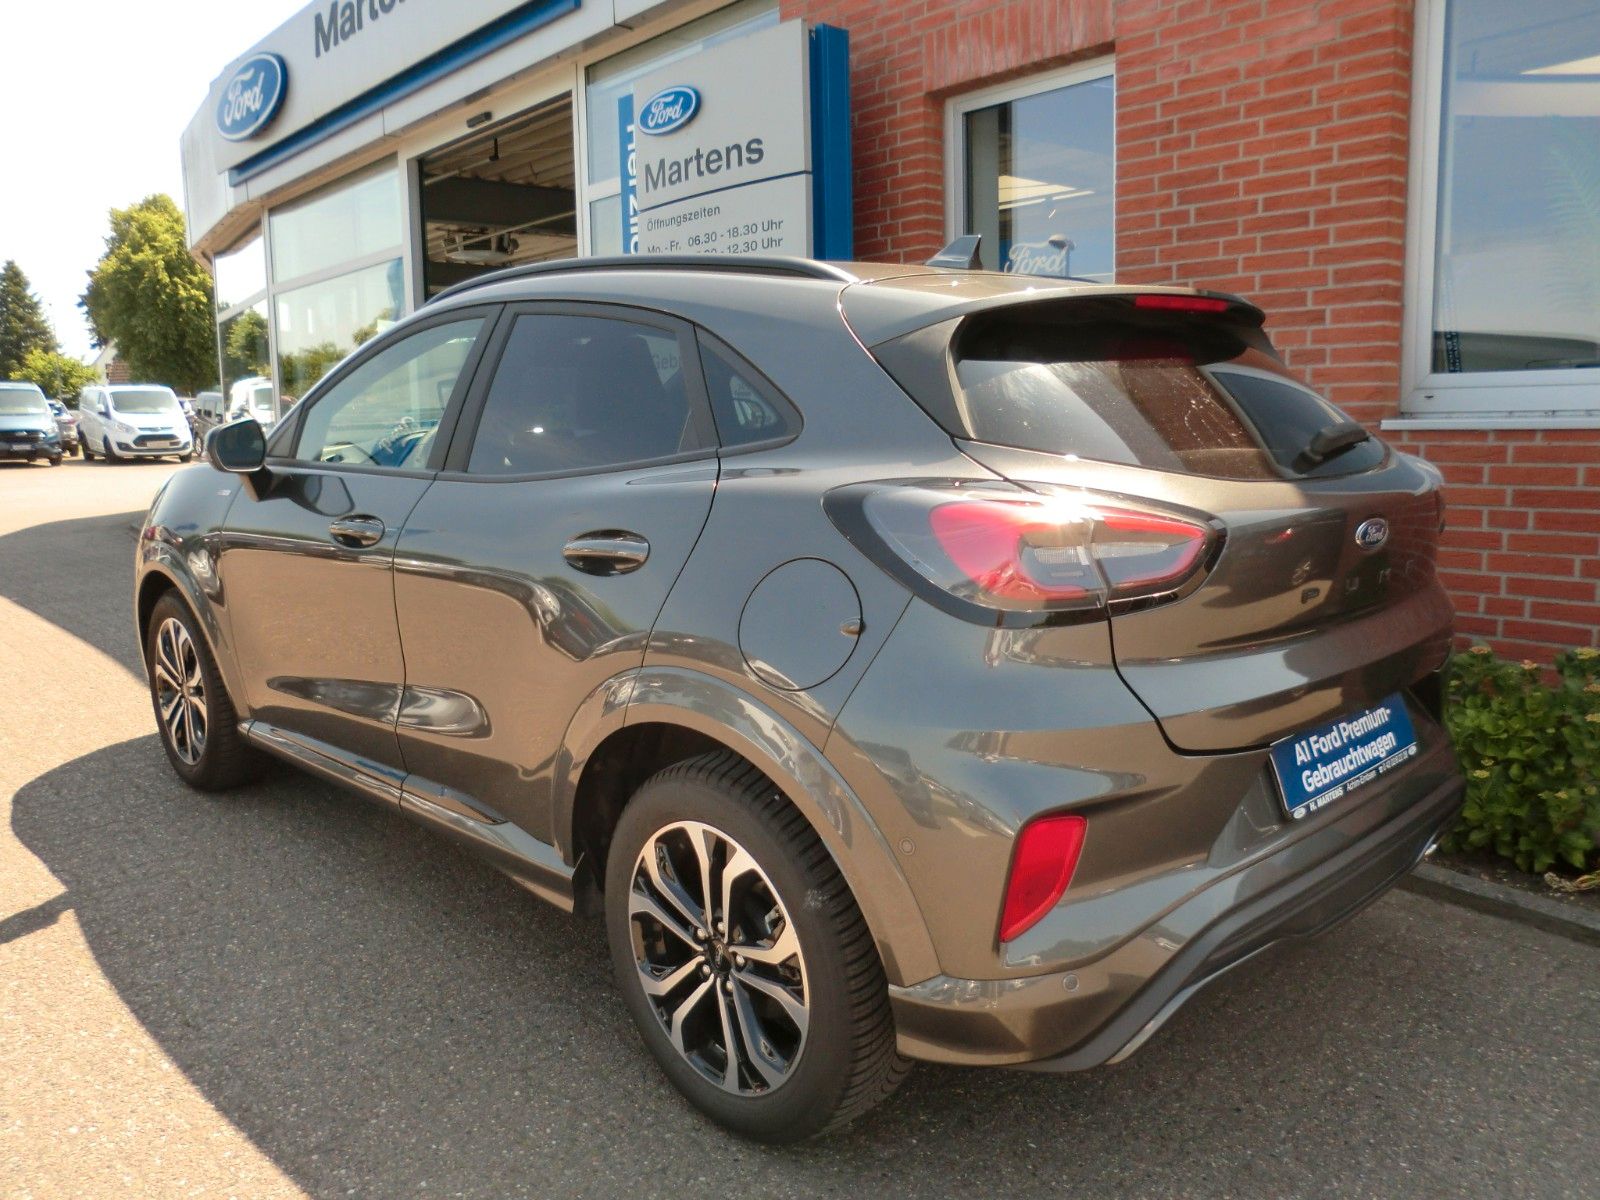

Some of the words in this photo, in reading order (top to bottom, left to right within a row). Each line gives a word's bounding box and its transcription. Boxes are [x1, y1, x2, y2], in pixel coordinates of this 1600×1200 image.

[224, 67, 264, 127] Ford
[648, 94, 684, 127] Ford
[644, 137, 765, 193] Martens
[647, 205, 721, 232] Öffnungszeiten
[670, 241, 682, 251] Fr.
[688, 231, 718, 247] 06.30
[726, 223, 758, 239] 18.30
[761, 219, 784, 232] Uhr
[727, 240, 758, 254] 12.30
[761, 237, 784, 249] Uhr
[1004, 234, 1070, 274] Ford
[1309, 725, 1341, 758] Ford
[1338, 706, 1391, 744] Premium-
[1301, 731, 1397, 793] Gebrauchtwagen
